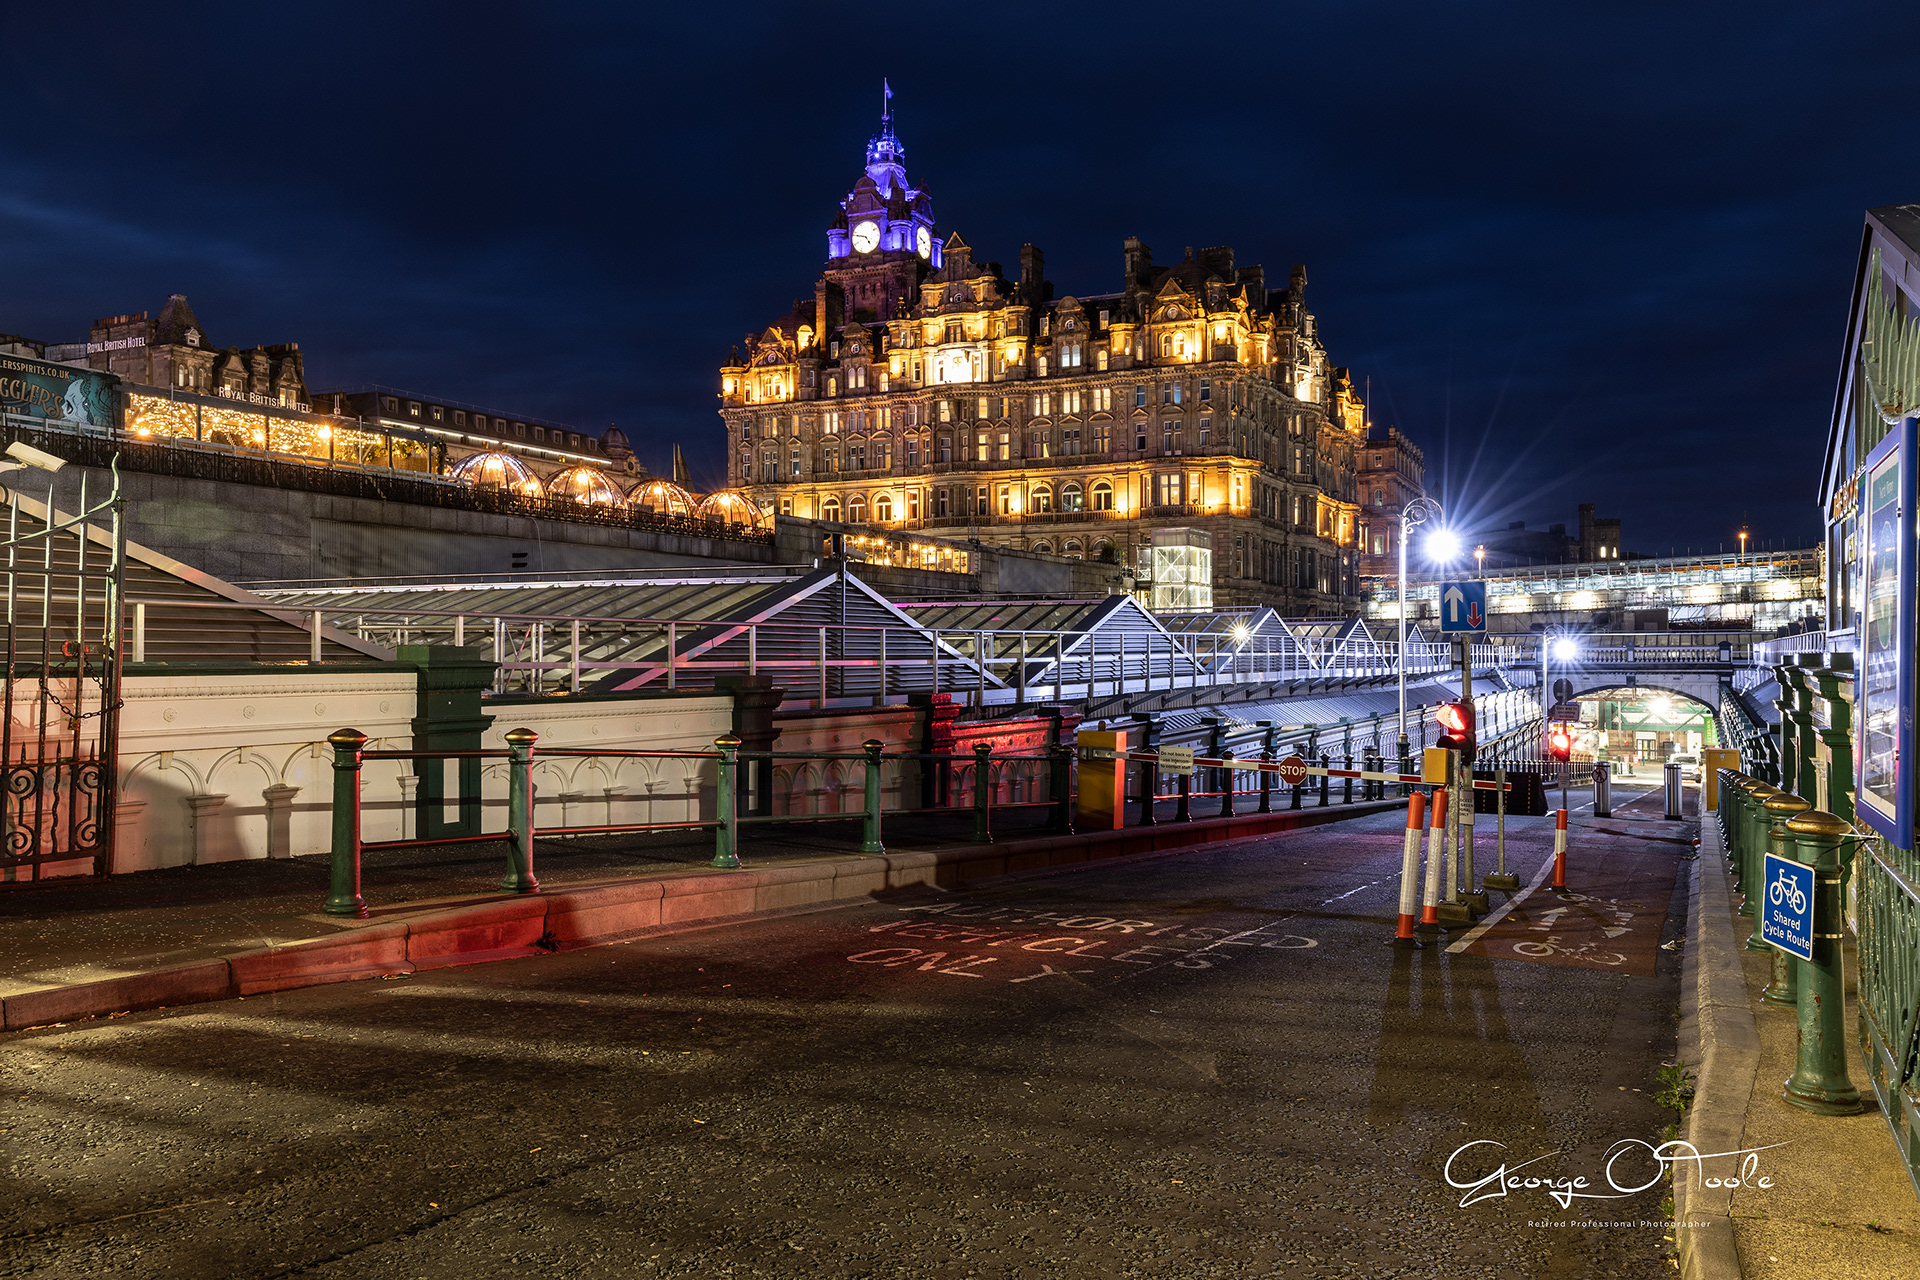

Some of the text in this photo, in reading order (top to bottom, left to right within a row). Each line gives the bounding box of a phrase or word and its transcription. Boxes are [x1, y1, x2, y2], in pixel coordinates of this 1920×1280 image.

[86, 336, 147, 355] ROYAL BRITISH HOTEL
[218, 386, 313, 414] ROYAL BRITISH HOTEL
[1280, 765, 1306, 776] STOP
[1773, 909, 1801, 931] Shared
[870, 919, 1233, 969] VEHICLES
[1763, 920, 1810, 950] Cycle Route
[847, 947, 1094, 983] ONLY
